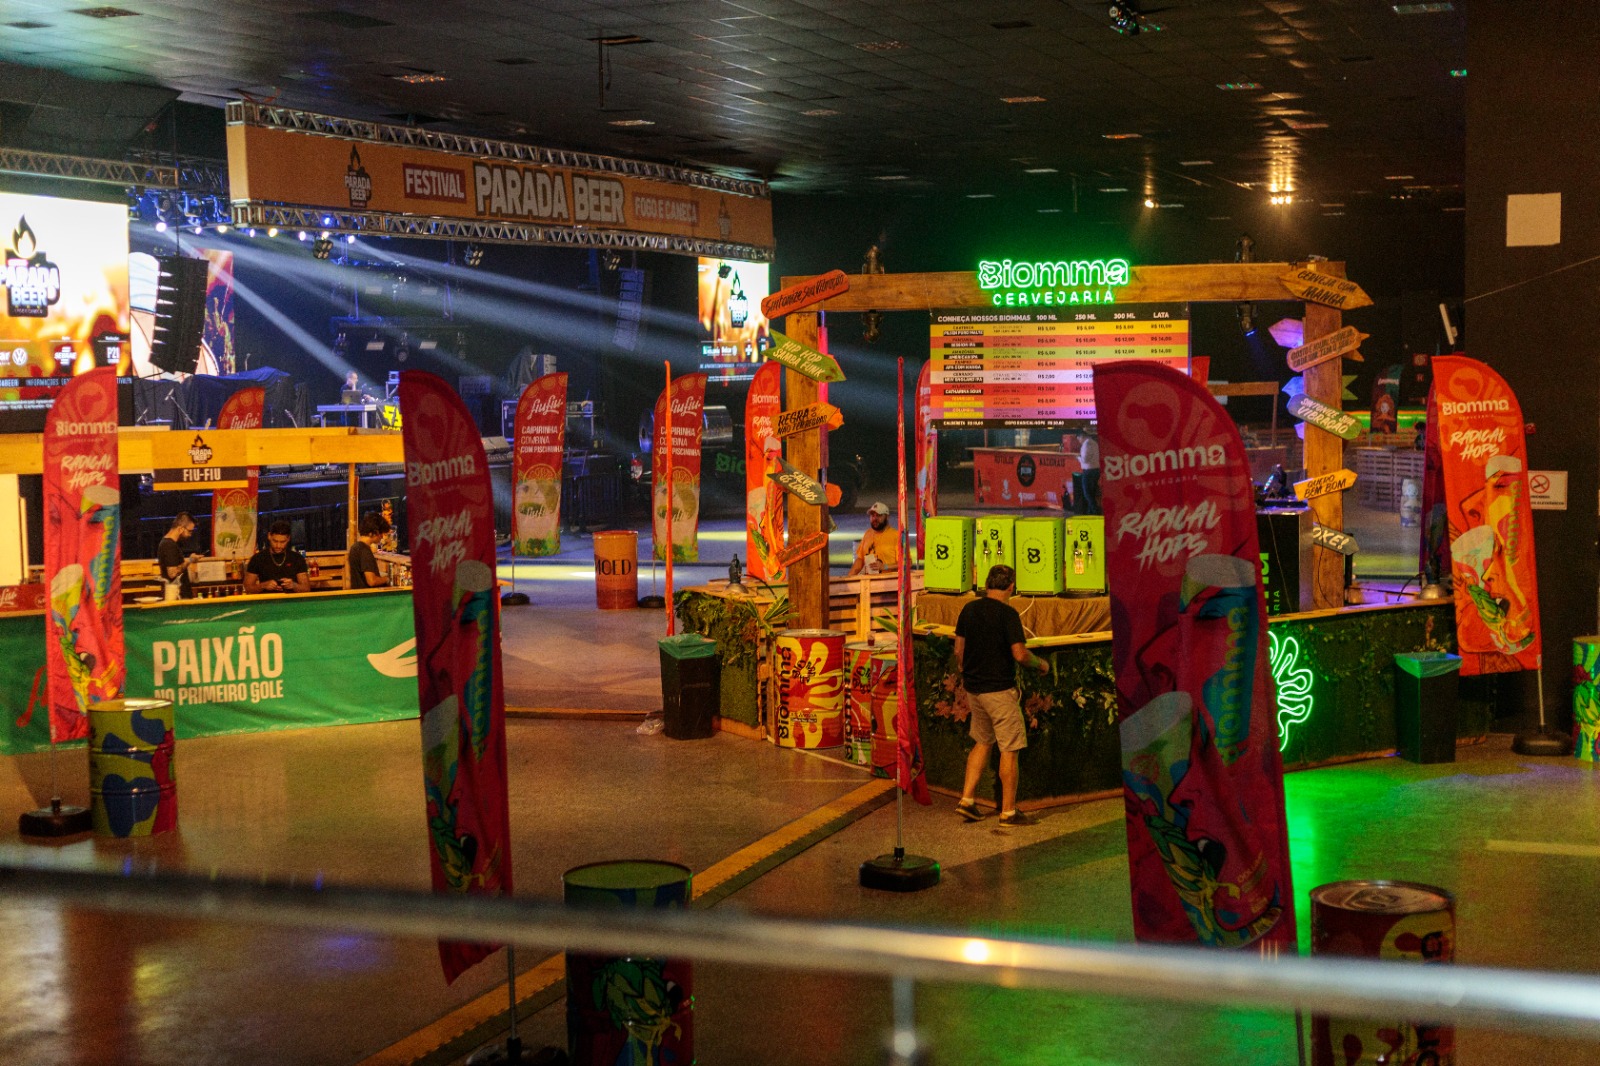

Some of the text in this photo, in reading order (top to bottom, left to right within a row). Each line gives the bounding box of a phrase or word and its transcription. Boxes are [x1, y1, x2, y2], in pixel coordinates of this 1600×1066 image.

[344, 175, 371, 190] PARADA
[405, 167, 465, 199] FESTIVAL
[474, 163, 625, 223] PARADA BEER
[351, 188, 367, 201] BEER
[635, 197, 697, 222] FOGO E CANECA
[0, 266, 59, 288] PARADA
[978, 258, 1129, 289] Biomma
[1297, 270, 1357, 293] CERVEJA COM
[11, 287, 47, 306] BEER
[992, 290, 1114, 306] CERVEJARIA
[1301, 286, 1347, 307] MANGA
[782, 340, 823, 363] HIP HOP
[772, 348, 826, 377] SAMBA FUNK
[752, 394, 778, 404] Biomma
[1441, 399, 1510, 416] Biomma
[1300, 397, 1356, 427] SINTONIZE SUA
[55, 421, 118, 436] Biomma
[521, 425, 558, 435] CAIPIRINHA
[1449, 426, 1507, 447] RADICAL
[520, 435, 550, 445] COMBINA
[520, 445, 564, 453] COM PISCININHA
[60, 453, 114, 472] RADICAL
[188, 448, 212, 456] PARADA
[1103, 444, 1226, 481] Biomma
[1459, 443, 1500, 462] HOPS
[67, 470, 106, 490] HOPS
[183, 468, 221, 482] FIU-FIU
[789, 471, 816, 490] SALVE
[1134, 474, 1199, 490] CERVEJARIA
[1307, 474, 1335, 488] QUERO
[779, 474, 818, 501] OS LOUCOS
[1303, 478, 1347, 498] BEM BOM
[415, 508, 474, 550] RADICAL
[1116, 499, 1223, 544] RADICAL
[428, 538, 467, 577] HOPS
[1135, 531, 1208, 573] HOPS
[152, 625, 284, 687] PAIXÃO
[154, 679, 284, 706] NO PRIMEIRO GOLE
[778, 646, 792, 739] Biomma
